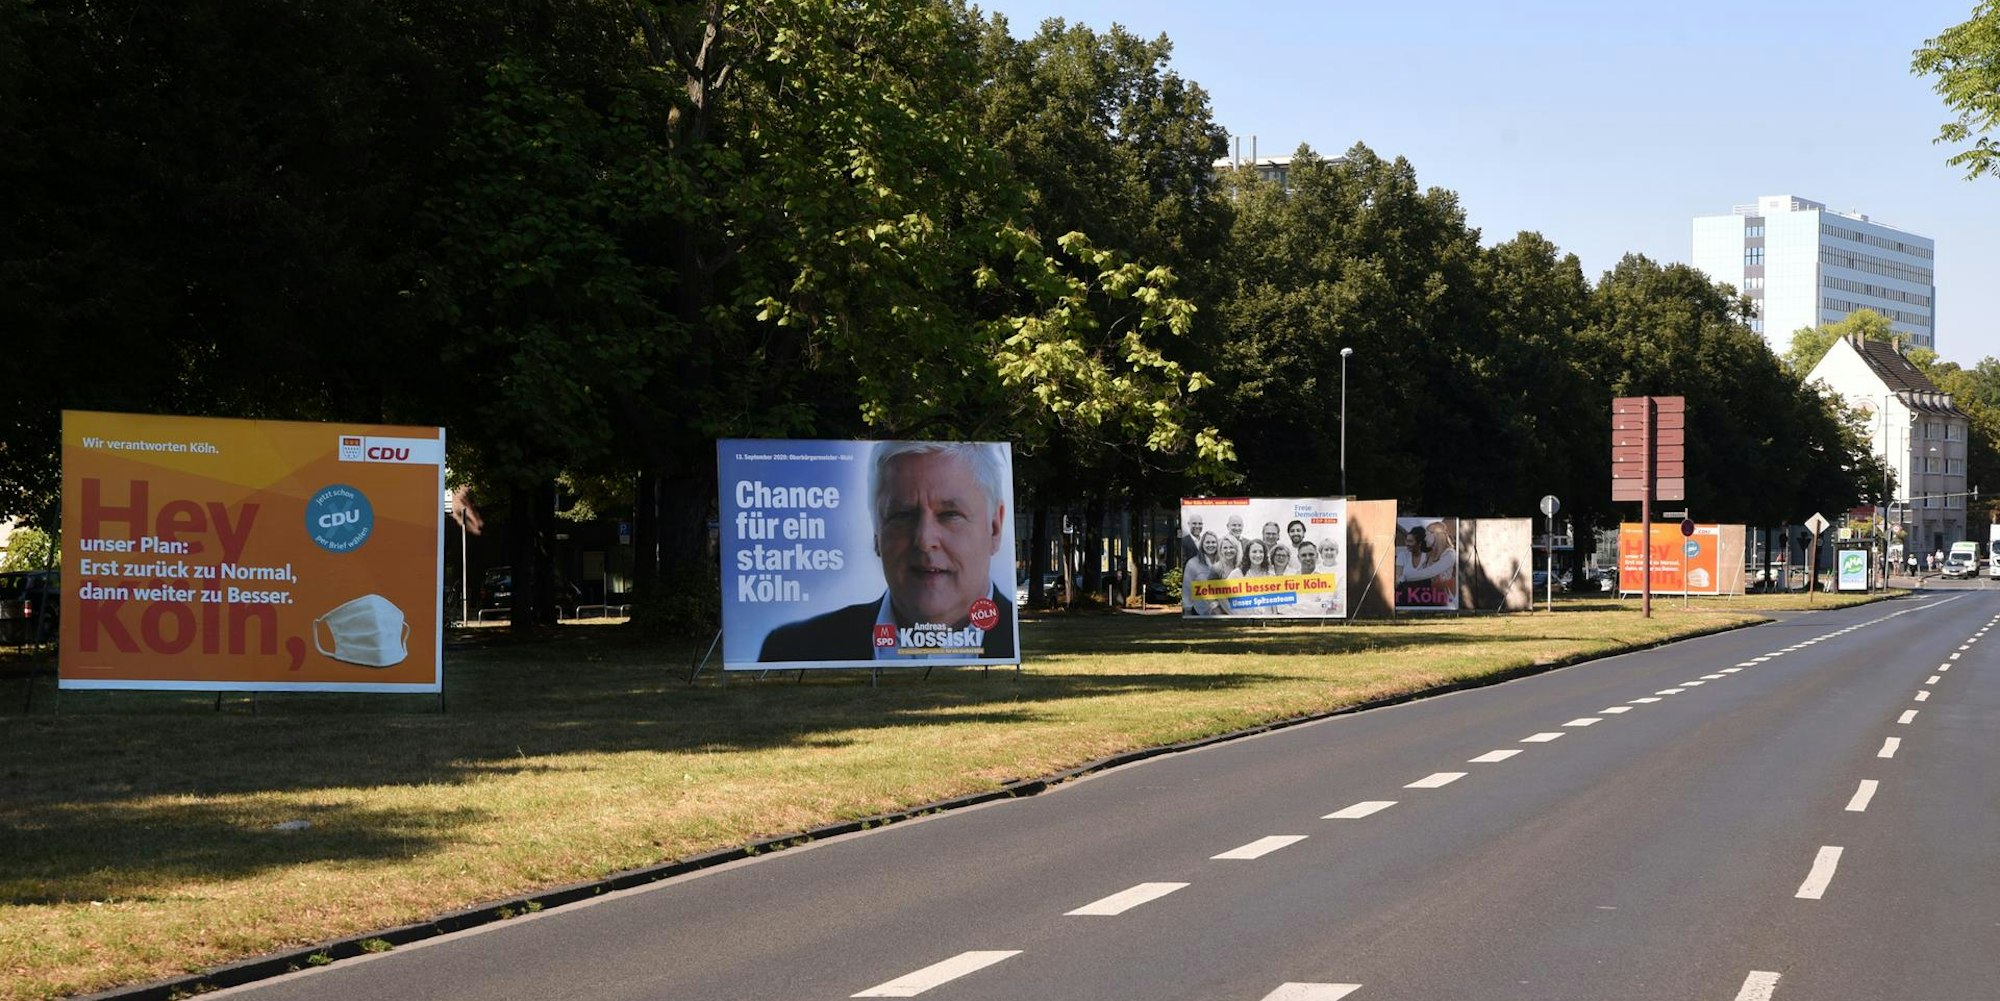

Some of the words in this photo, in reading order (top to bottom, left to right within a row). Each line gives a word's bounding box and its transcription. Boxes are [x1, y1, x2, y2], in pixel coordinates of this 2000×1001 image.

[83, 437, 103, 448] Wir
[108, 440, 187, 453] verantworten
[190, 442, 219, 454] Köln.
[367, 447, 410, 460] CDU
[333, 489, 354, 499] schon
[736, 480, 840, 509] Chance
[81, 478, 259, 573] Hey
[318, 509, 359, 528] CDU
[736, 511, 779, 540] für
[783, 512, 825, 540] ein
[80, 538, 135, 552] unser
[141, 537, 189, 554] Plan:
[315, 535, 328, 546] per
[329, 541, 347, 550] Brief
[348, 526, 368, 548] wählen
[737, 544, 844, 571] starkes
[80, 559, 119, 576] Erst
[124, 561, 189, 578] zurück
[194, 566, 215, 578] zu
[221, 563, 297, 584] Normal,
[80, 583, 128, 600] dann
[133, 585, 196, 602] weiter
[201, 590, 222, 603] zu
[228, 587, 293, 604] Besser.
[738, 574, 809, 602] Köln.
[1195, 582, 1242, 596] Zehnmal
[1246, 582, 1281, 593] besser
[1284, 580, 1300, 590] für
[1303, 578, 1331, 589] Köln.
[1253, 596, 1295, 606] Spitzenteam
[79, 576, 307, 671] Köln,
[971, 608, 997, 621] KÖLN
[876, 638, 894, 646] SPD
[900, 627, 984, 648] Kossiski
